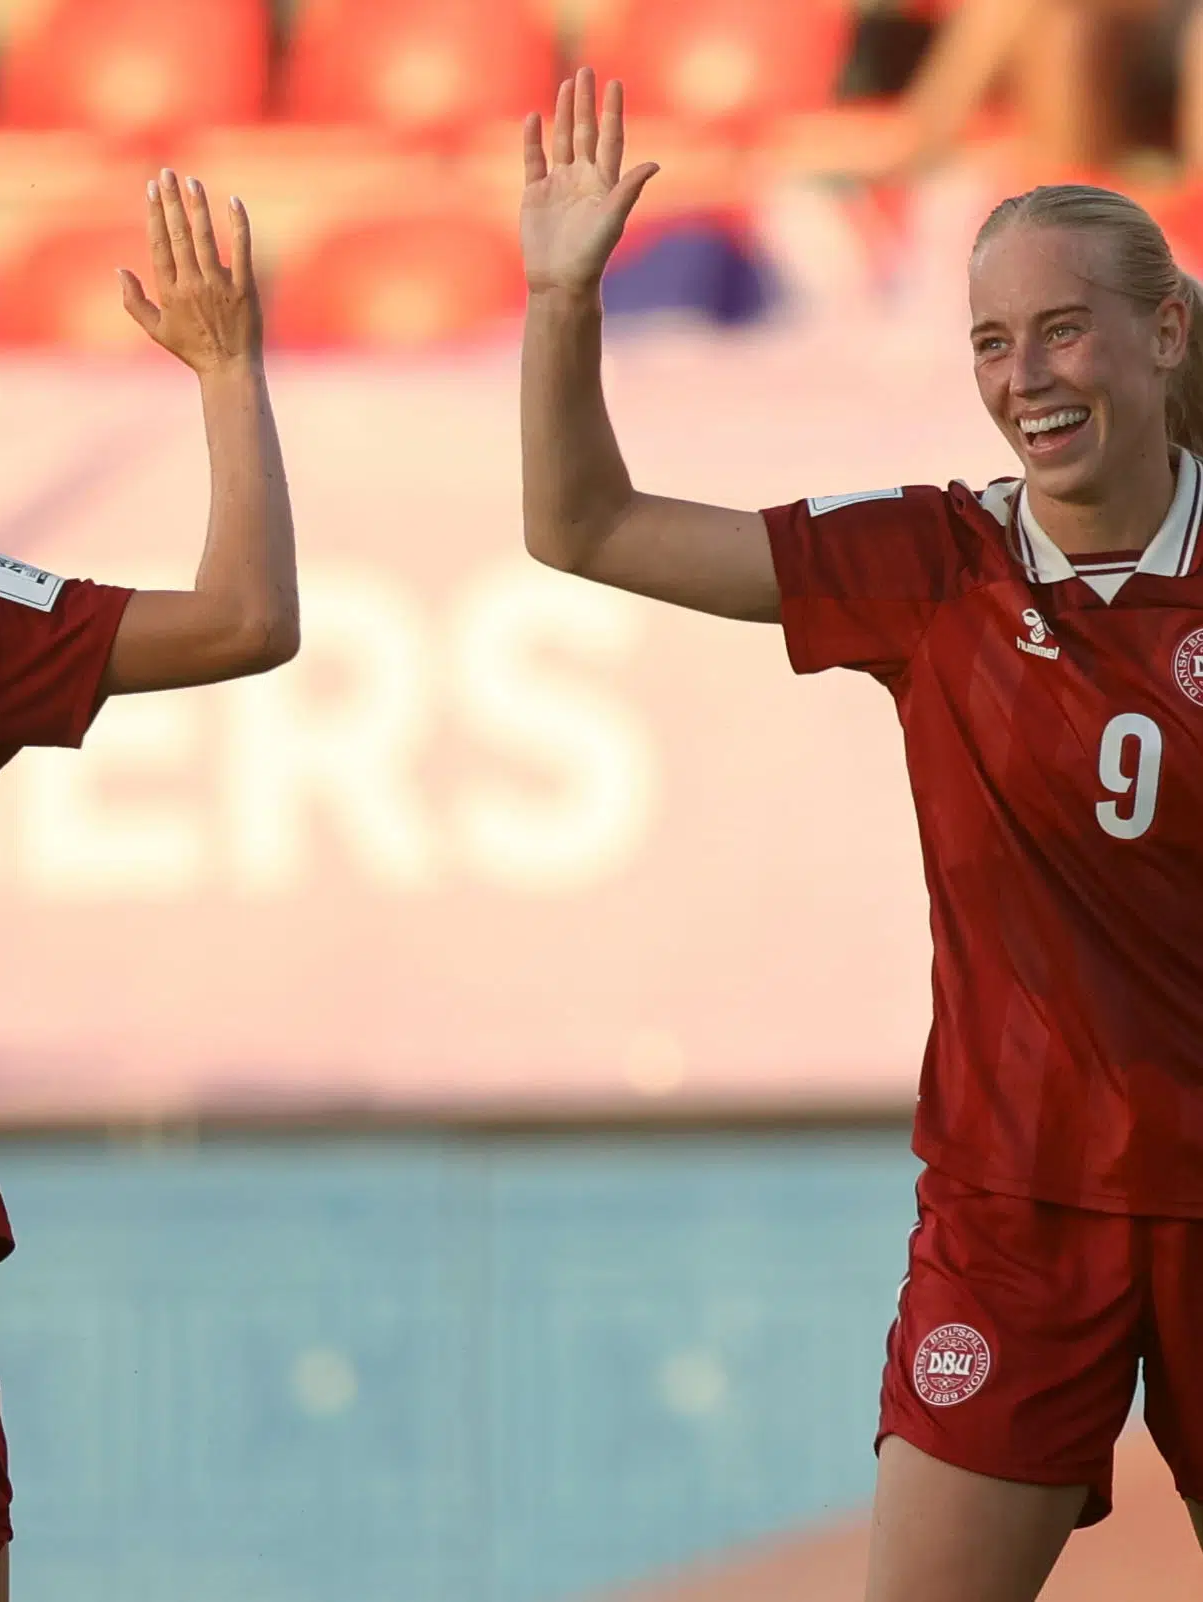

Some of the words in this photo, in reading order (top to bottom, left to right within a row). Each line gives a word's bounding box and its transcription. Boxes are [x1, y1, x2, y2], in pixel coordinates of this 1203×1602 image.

[1016, 635, 1060, 660] hummel
[1178, 650, 1199, 697] DANSK
[1095, 713, 1163, 840] 9
[927, 1350, 974, 1376] DBU
[962, 1352, 986, 1394] UNION
[929, 1391, 958, 1403] 1889
